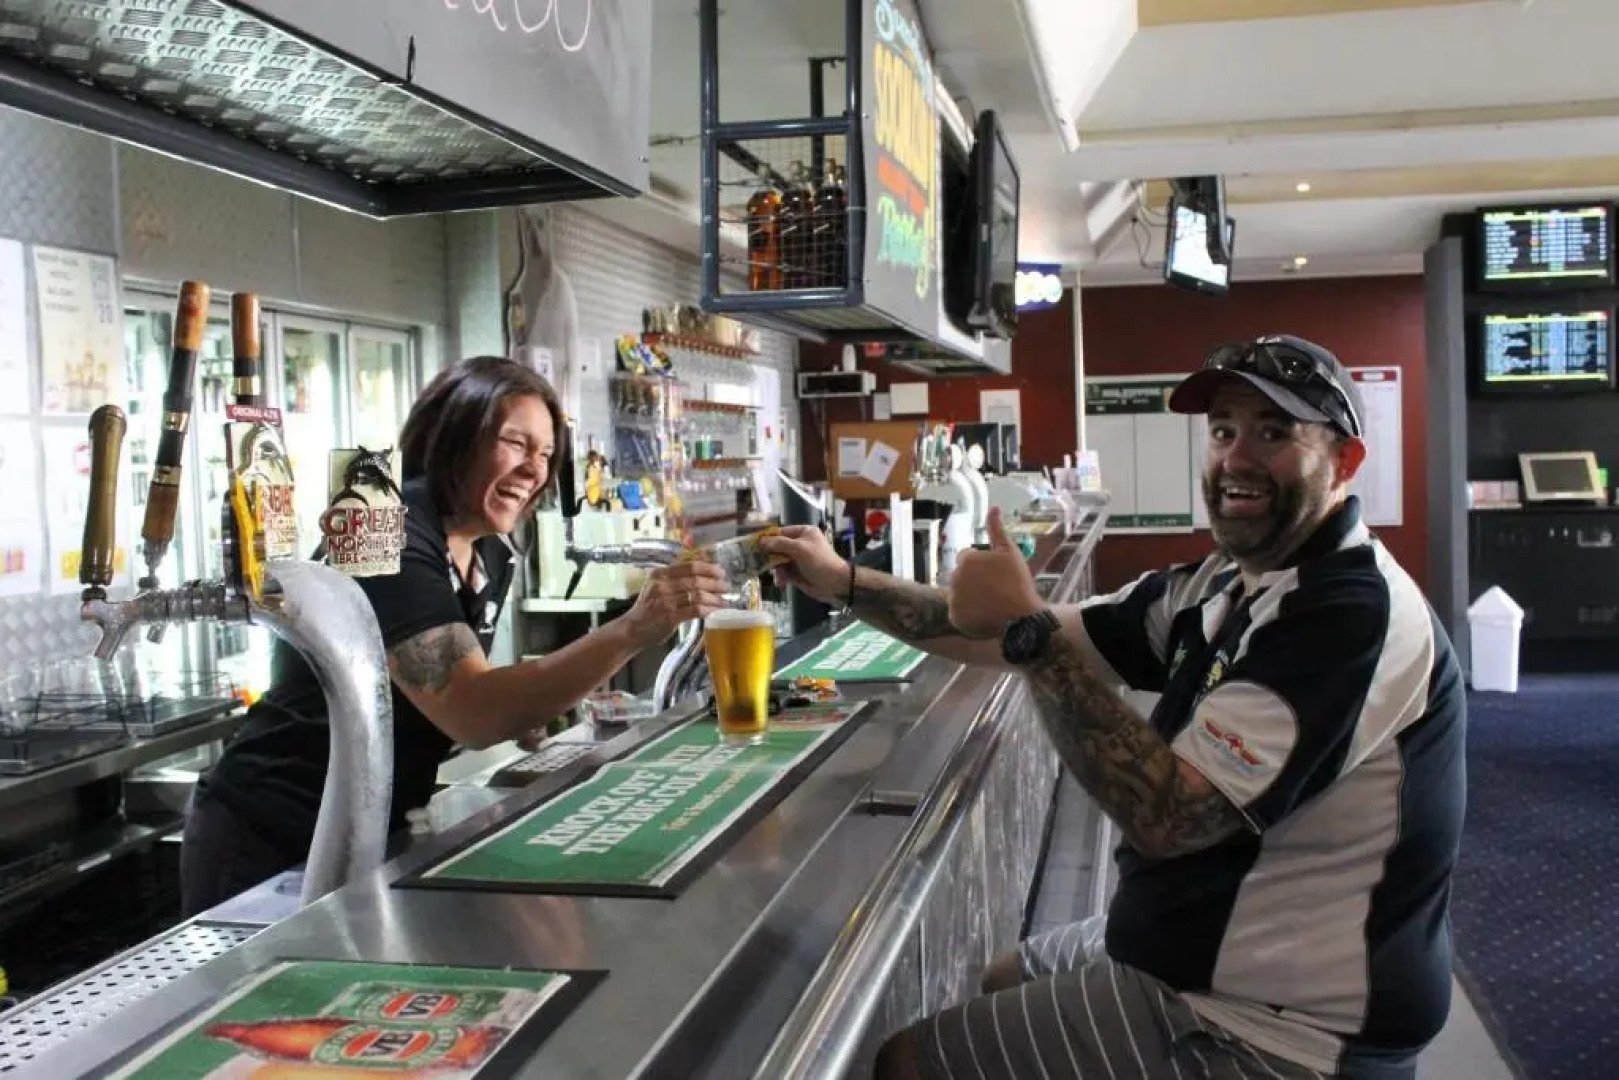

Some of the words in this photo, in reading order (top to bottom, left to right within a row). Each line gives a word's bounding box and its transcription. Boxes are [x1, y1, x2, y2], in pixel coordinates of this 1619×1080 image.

[322, 506, 408, 535] GREAT
[526, 796, 632, 846] KNOCK
[608, 770, 666, 801] OFF
[562, 822, 642, 855] THE
[612, 798, 676, 823] BIG
[398, 993, 443, 1015] VB
[362, 1031, 413, 1056] VB
